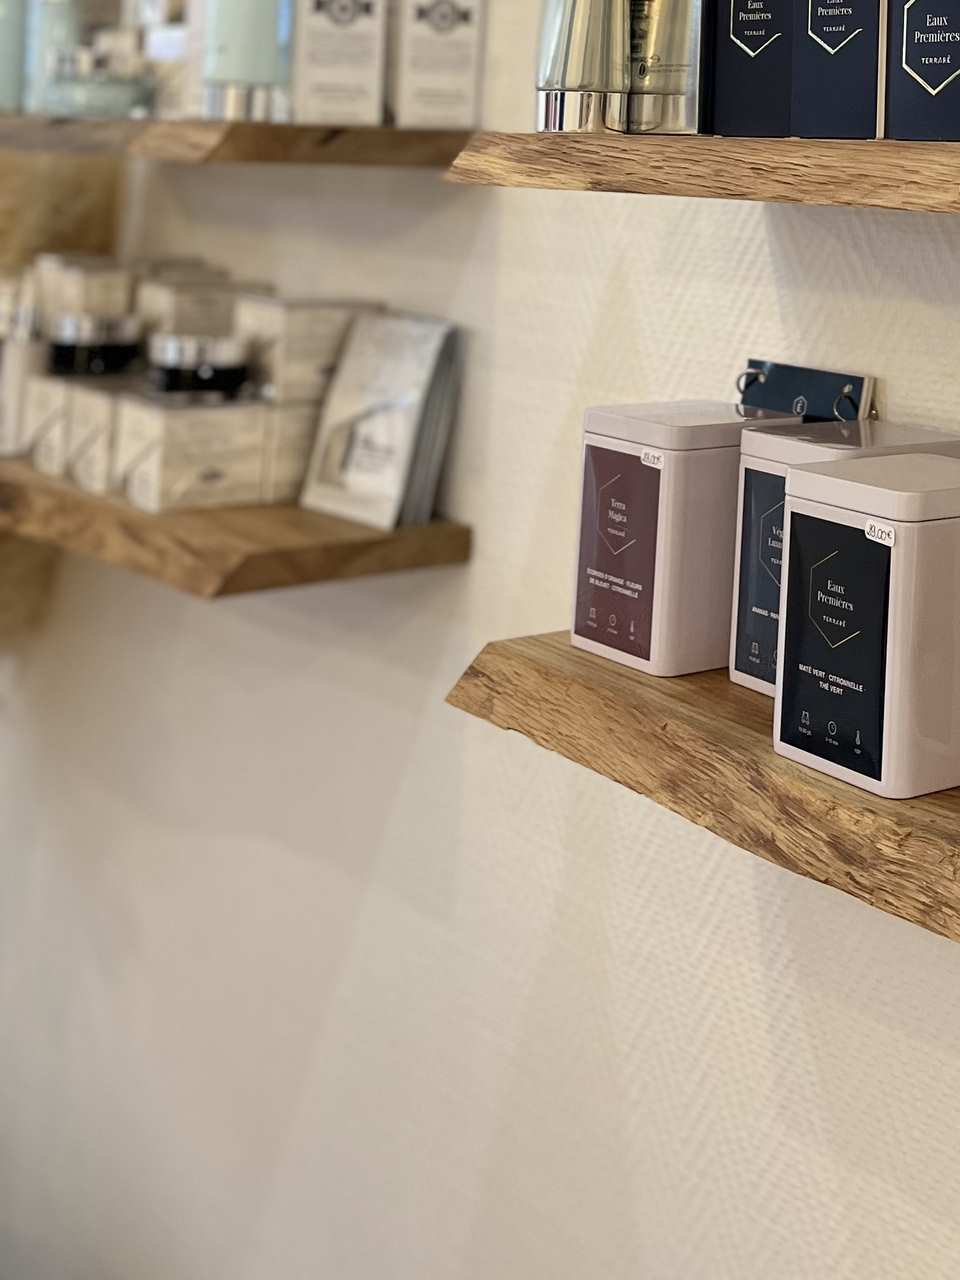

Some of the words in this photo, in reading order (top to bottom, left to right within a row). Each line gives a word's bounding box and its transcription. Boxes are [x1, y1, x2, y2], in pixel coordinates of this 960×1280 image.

[747, 0, 764, 9] Eaux
[739, 11, 771, 21] Premières
[817, 6, 852, 17] Premières
[926, 14, 948, 27] Eaux
[914, 29, 960, 43] Premières
[827, 579, 845, 595] Eaux
[817, 591, 854, 612] Premières
[813, 668, 825, 679] VERT
[828, 674, 864, 693] CITRONNELLE
[830, 685, 843, 695] VERT
